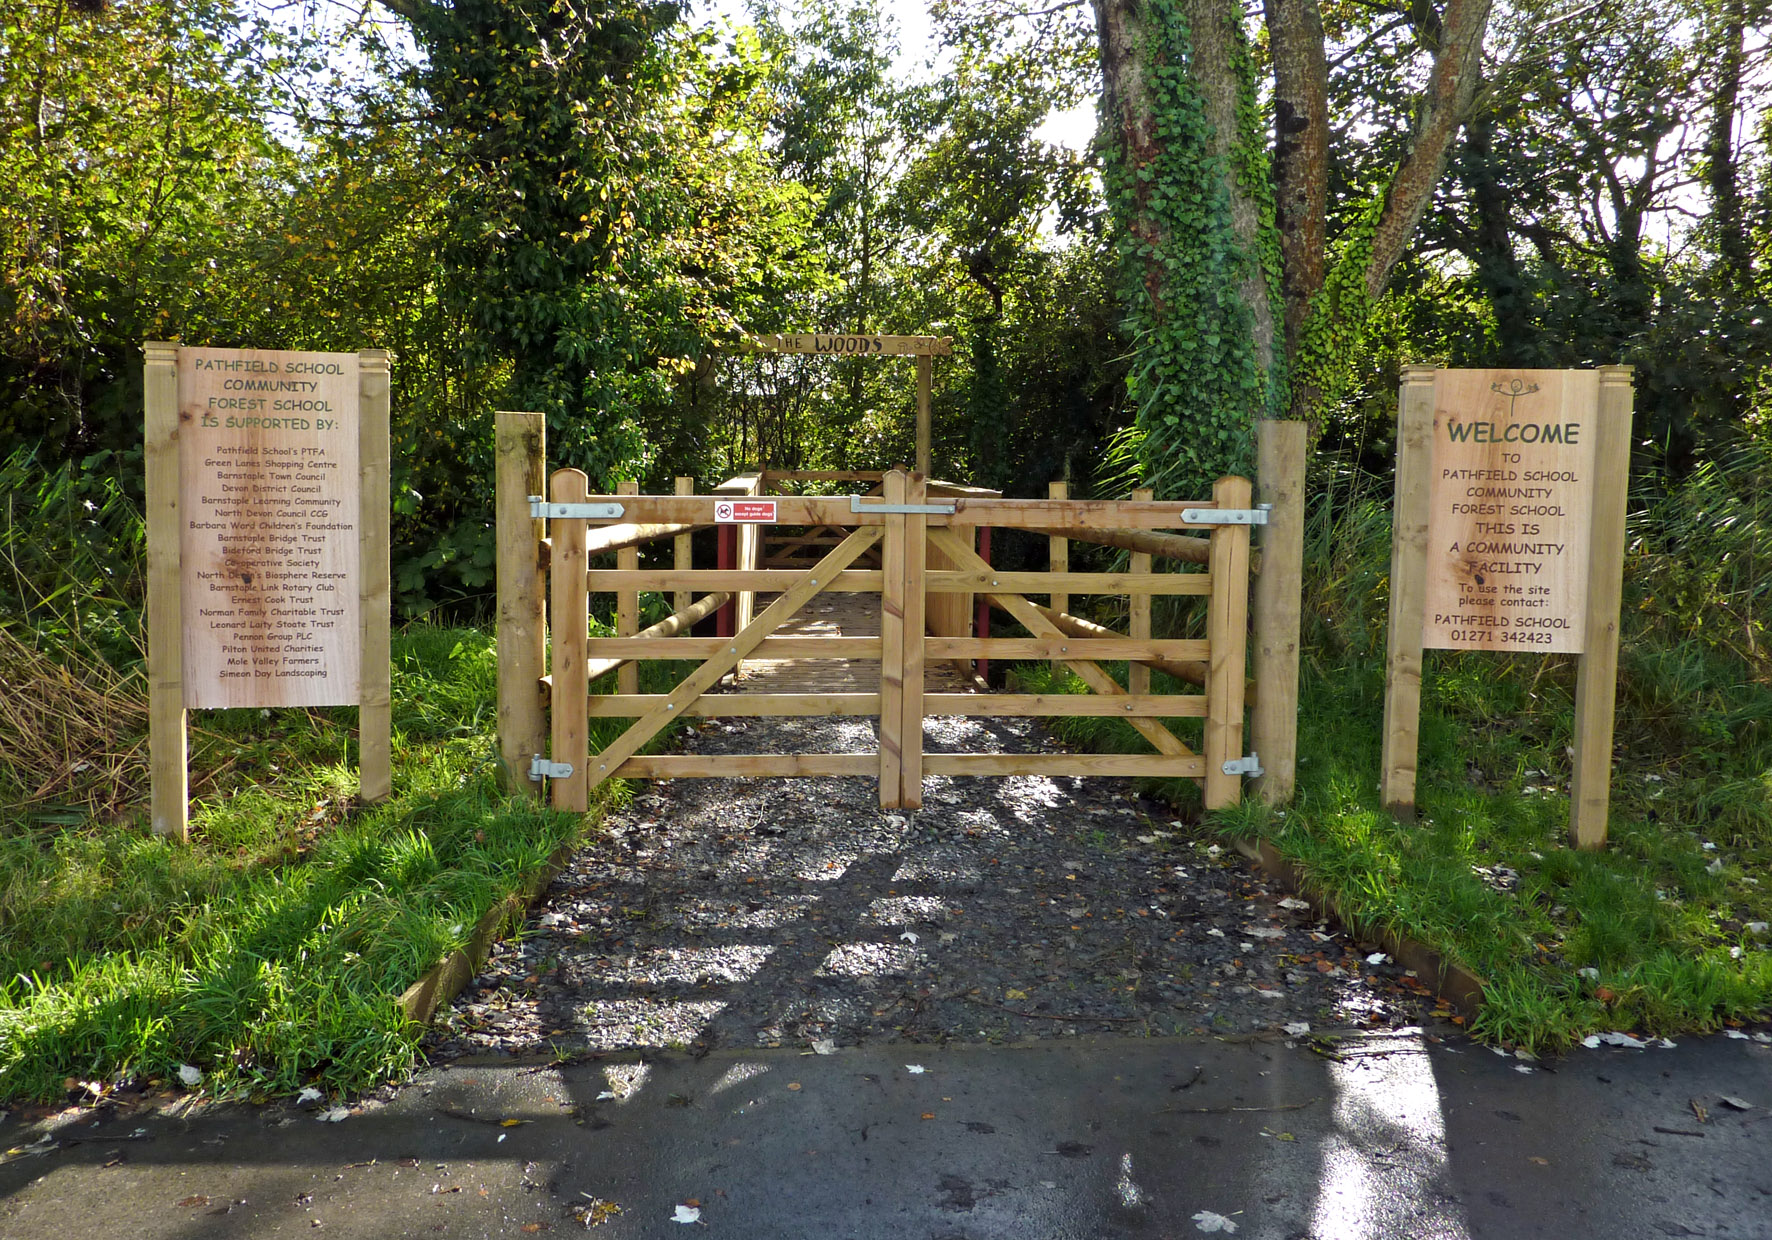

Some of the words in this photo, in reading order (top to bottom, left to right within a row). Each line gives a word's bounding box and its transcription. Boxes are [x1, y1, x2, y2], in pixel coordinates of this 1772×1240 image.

[776, 336, 802, 349] THE
[815, 337, 882, 353] WOODS
[195, 359, 278, 373] PATHFIELD
[285, 363, 344, 375] SCHOOL
[224, 380, 317, 392] COMMUNITY
[208, 398, 266, 410] FOREST
[273, 400, 333, 412] SCHOOL
[201, 416, 219, 428] IS
[226, 416, 310, 430] SUPPORTED
[316, 419, 339, 430] BY:
[1447, 422, 1580, 444] WELCOME
[217, 446, 258, 455] Pathfield
[1502, 453, 1521, 464] TO
[266, 461, 304, 469] Shopping
[217, 472, 265, 481] Barnstaple
[1443, 469, 1517, 481] PATHFIELD
[1523, 471, 1578, 482] SCHOOL
[1467, 488, 1552, 498] COMMUNITY
[202, 497, 249, 506] Barnstaple
[253, 498, 291, 506] Learning
[295, 498, 341, 507] Community
[1452, 504, 1504, 515] FOREST
[1510, 506, 1565, 516] SCHOOL
[1476, 523, 1515, 534] THIS
[1522, 524, 1540, 535] IS
[218, 534, 265, 543] Barnstaple
[269, 535, 298, 544] Bridge
[266, 547, 293, 556] Bridge
[1450, 542, 1460, 552] A
[1467, 542, 1564, 555] COMMUNITY
[225, 560, 282, 569] Co-operative
[287, 560, 320, 568] Society
[1468, 561, 1542, 574] FACILITY
[266, 572, 308, 580] Biosphere
[210, 584, 257, 593] Barnstaple
[283, 584, 312, 593] Rotary
[1459, 583, 1473, 593] To
[1479, 585, 1497, 593] use
[1504, 585, 1523, 594] the
[1528, 585, 1550, 595] site
[1459, 596, 1495, 607] please
[1500, 598, 1549, 607] contact:
[238, 609, 266, 617] Family
[250, 621, 272, 630] Laity
[1435, 614, 1509, 627] PATHFIELD
[1515, 618, 1570, 629] SCHOOL
[267, 633, 293, 642] Group
[1451, 630, 1493, 642] 01271
[1501, 632, 1552, 644] 342423
[252, 658, 279, 666] Valley
[255, 670, 271, 679] Day
[275, 670, 327, 678] Landscaping
